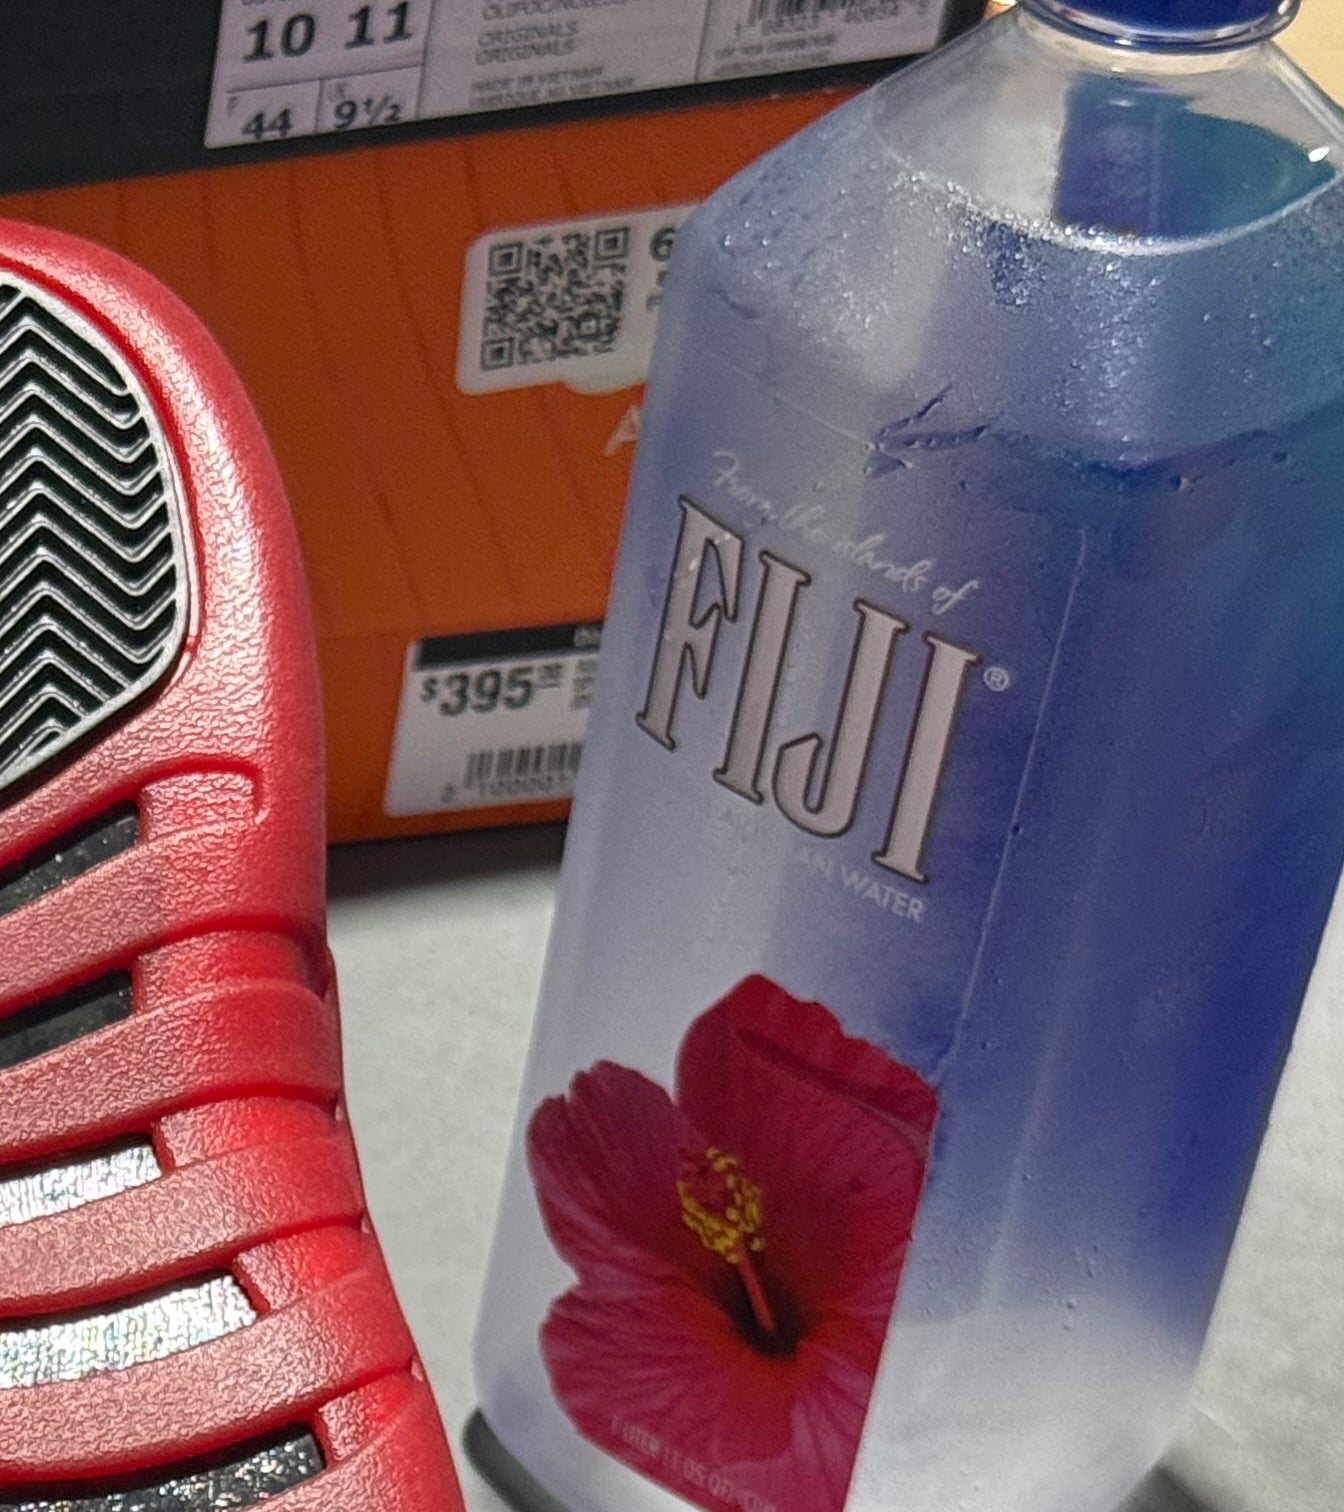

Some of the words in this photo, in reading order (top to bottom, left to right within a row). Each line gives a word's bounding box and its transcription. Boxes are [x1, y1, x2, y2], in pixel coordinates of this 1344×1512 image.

[242, 13, 316, 63] 10
[344, 1, 413, 49] 11
[241, 108, 293, 141] 44
[931, 577, 981, 616] of
[419, 666, 534, 717] $395
[840, 863, 925, 923] WATER
